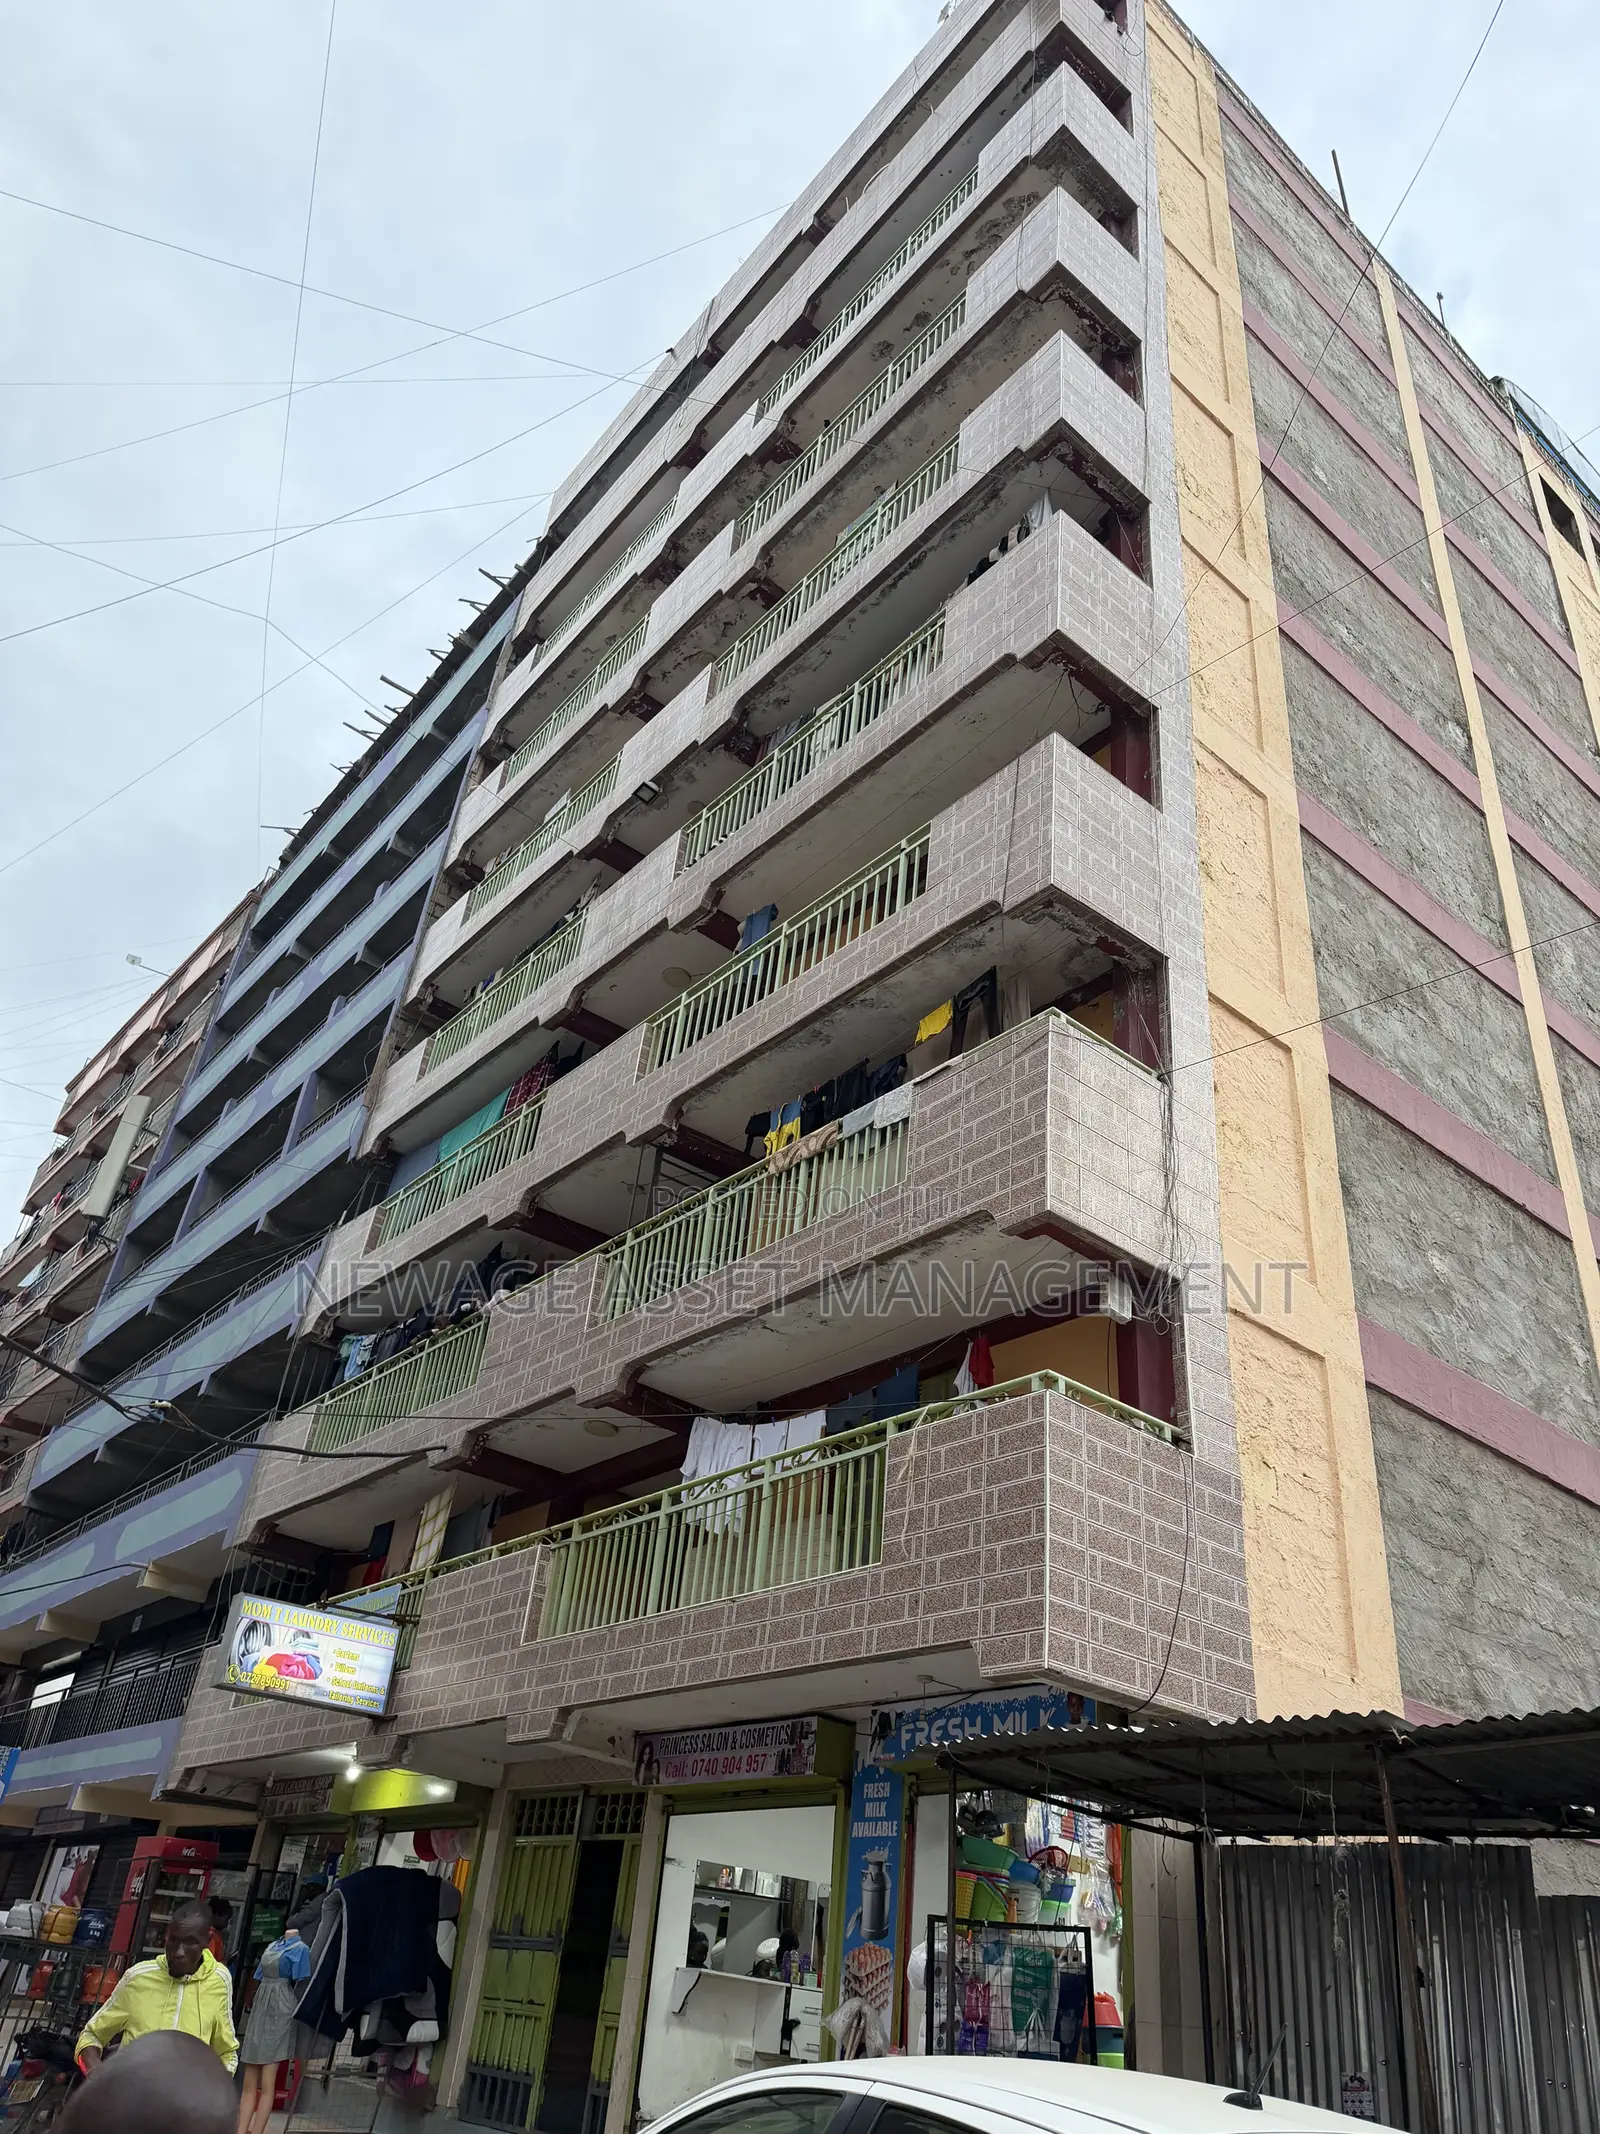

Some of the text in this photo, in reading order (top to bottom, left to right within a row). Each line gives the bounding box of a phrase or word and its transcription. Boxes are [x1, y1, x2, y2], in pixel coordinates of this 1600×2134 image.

[242, 1600, 273, 1620] MOM
[275, 1608, 284, 1622] T
[284, 1610, 342, 1634] LAUNDRY
[341, 1621, 396, 1647] SERVICES
[335, 1662, 357, 1675] Pillows
[240, 1671, 291, 1690] 0727890991
[331, 1676, 352, 1689] School
[353, 1680, 379, 1695] Uniforms
[328, 1689, 381, 1709] Tailoring Services
[660, 1723, 791, 1757] PRINCESS SALON & COSMETICS
[901, 1715, 981, 1751] FRESH
[664, 1753, 768, 1780] Call: 0740 904 957
[863, 1782, 891, 1799] FRESH
[864, 1801, 887, 1818] MILK
[851, 1821, 898, 1838] AVAILABLE
